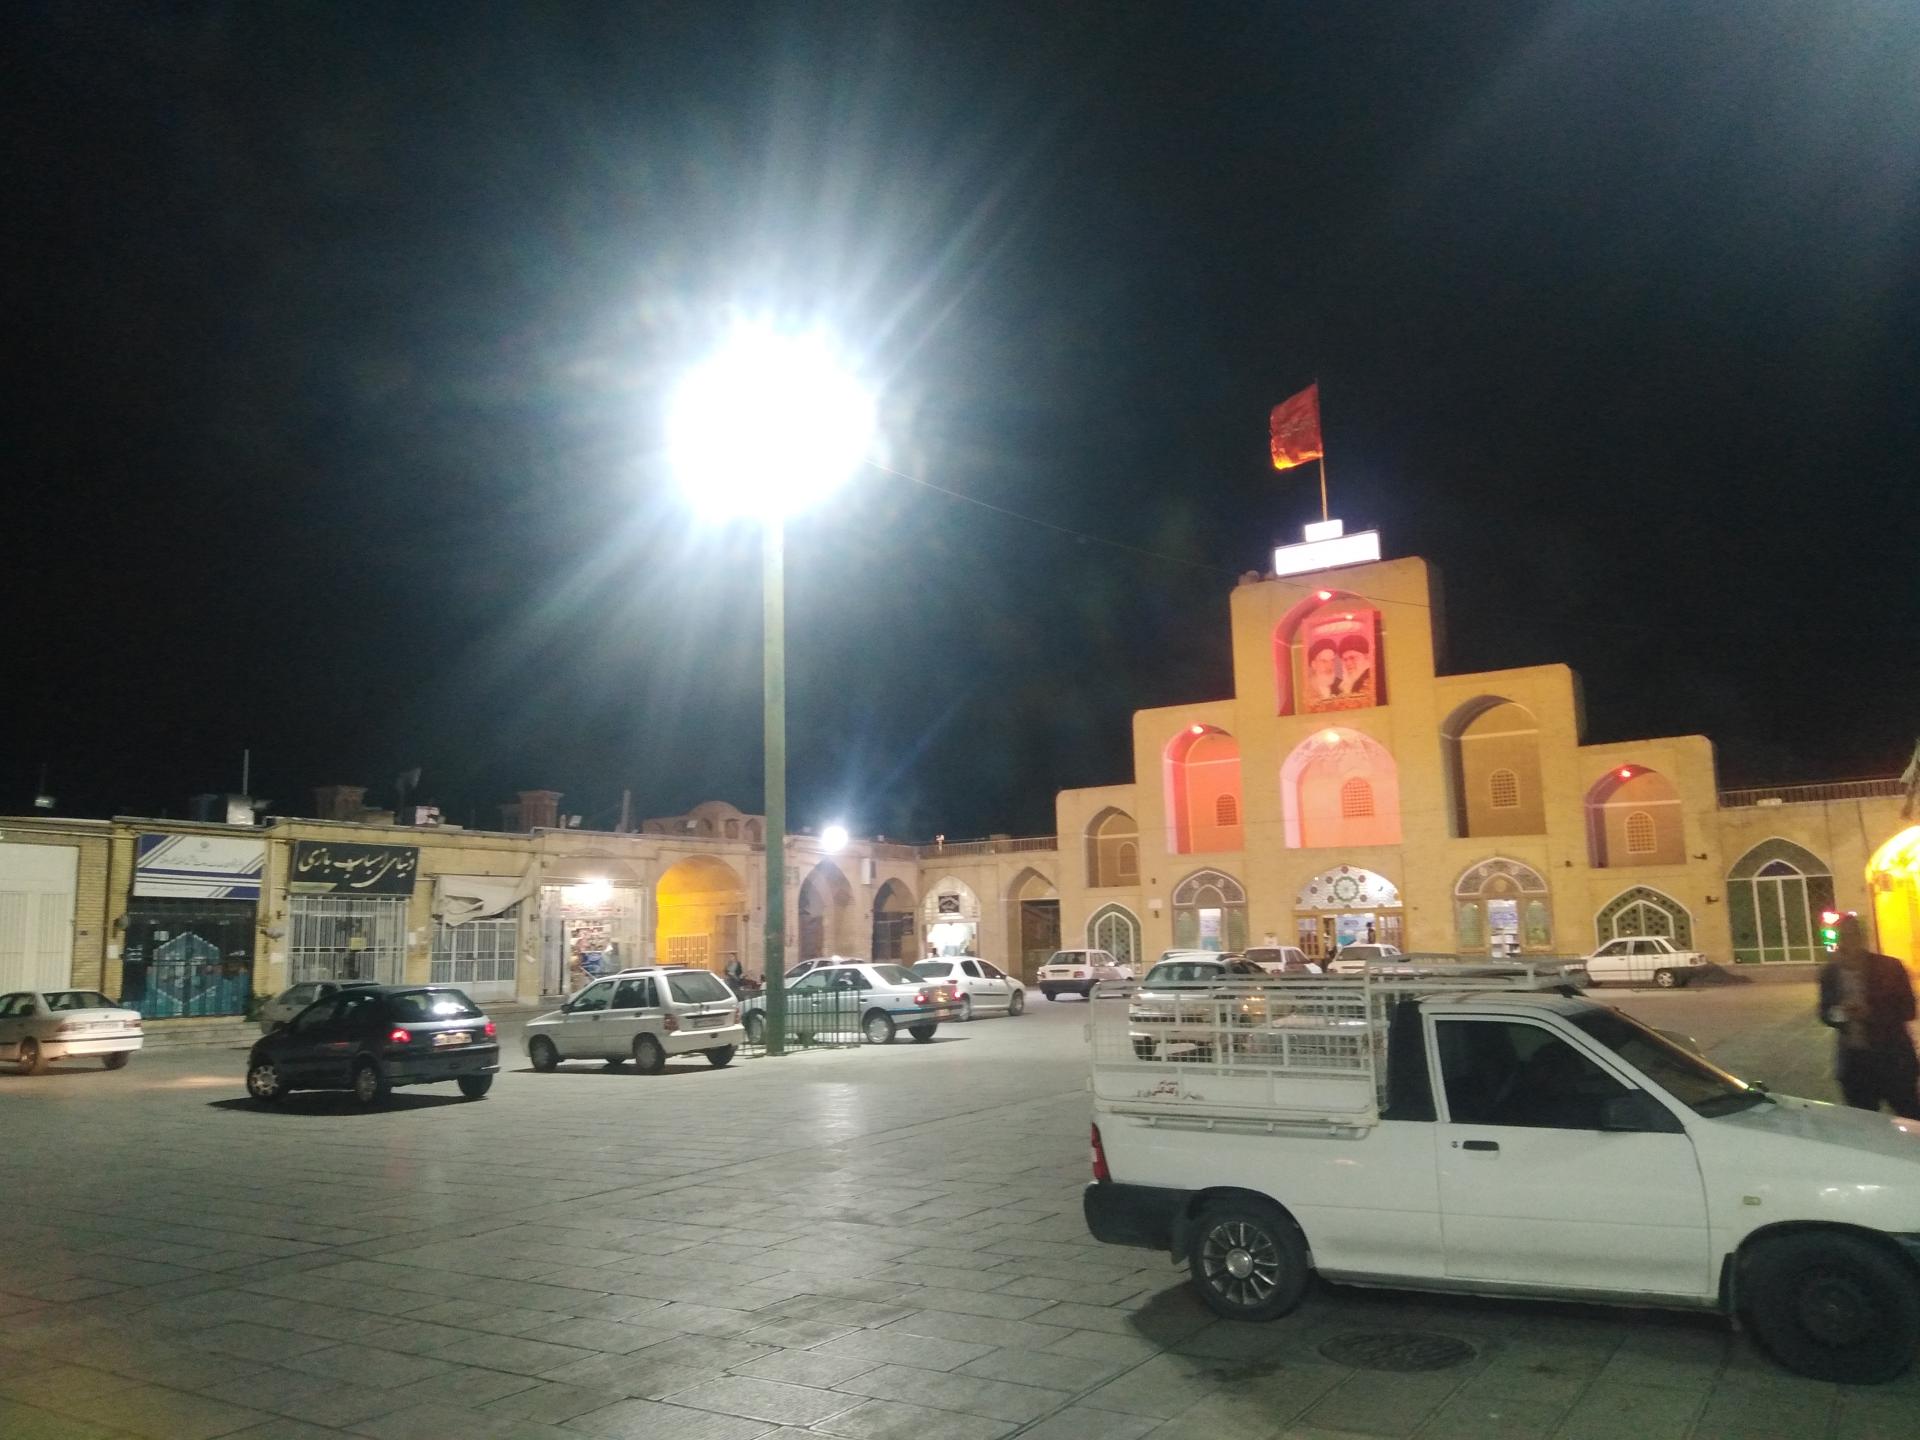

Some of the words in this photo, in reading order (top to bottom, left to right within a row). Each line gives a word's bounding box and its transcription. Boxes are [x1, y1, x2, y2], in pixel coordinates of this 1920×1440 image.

[298, 847, 331, 873] بازی
[333, 852, 389, 879] اسباب
[350, 851, 416, 888] دنیای
